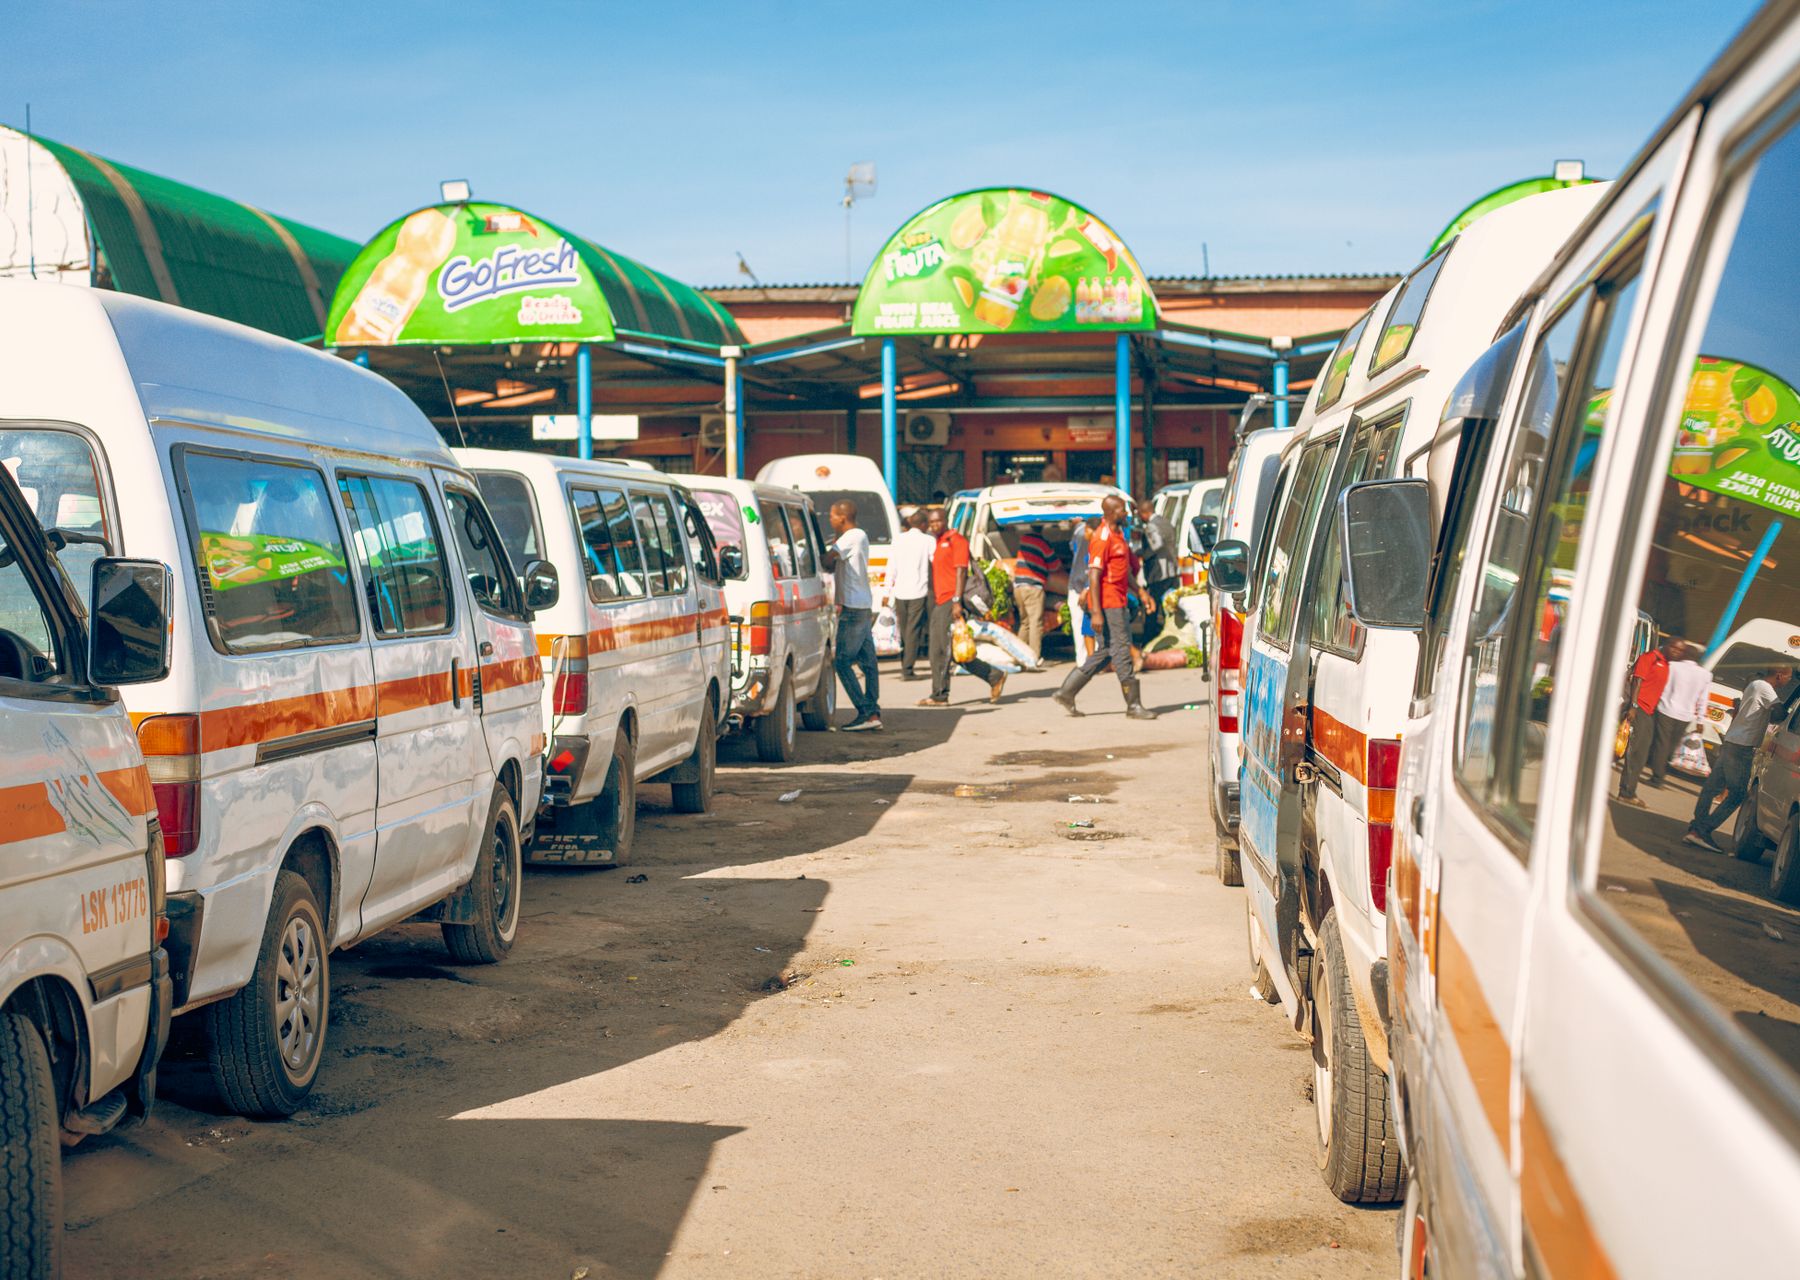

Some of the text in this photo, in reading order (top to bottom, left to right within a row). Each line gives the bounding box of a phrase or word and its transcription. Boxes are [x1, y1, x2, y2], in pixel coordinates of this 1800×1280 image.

[440, 238, 578, 296] GoFresh
[81, 877, 147, 934] LSK 13776
